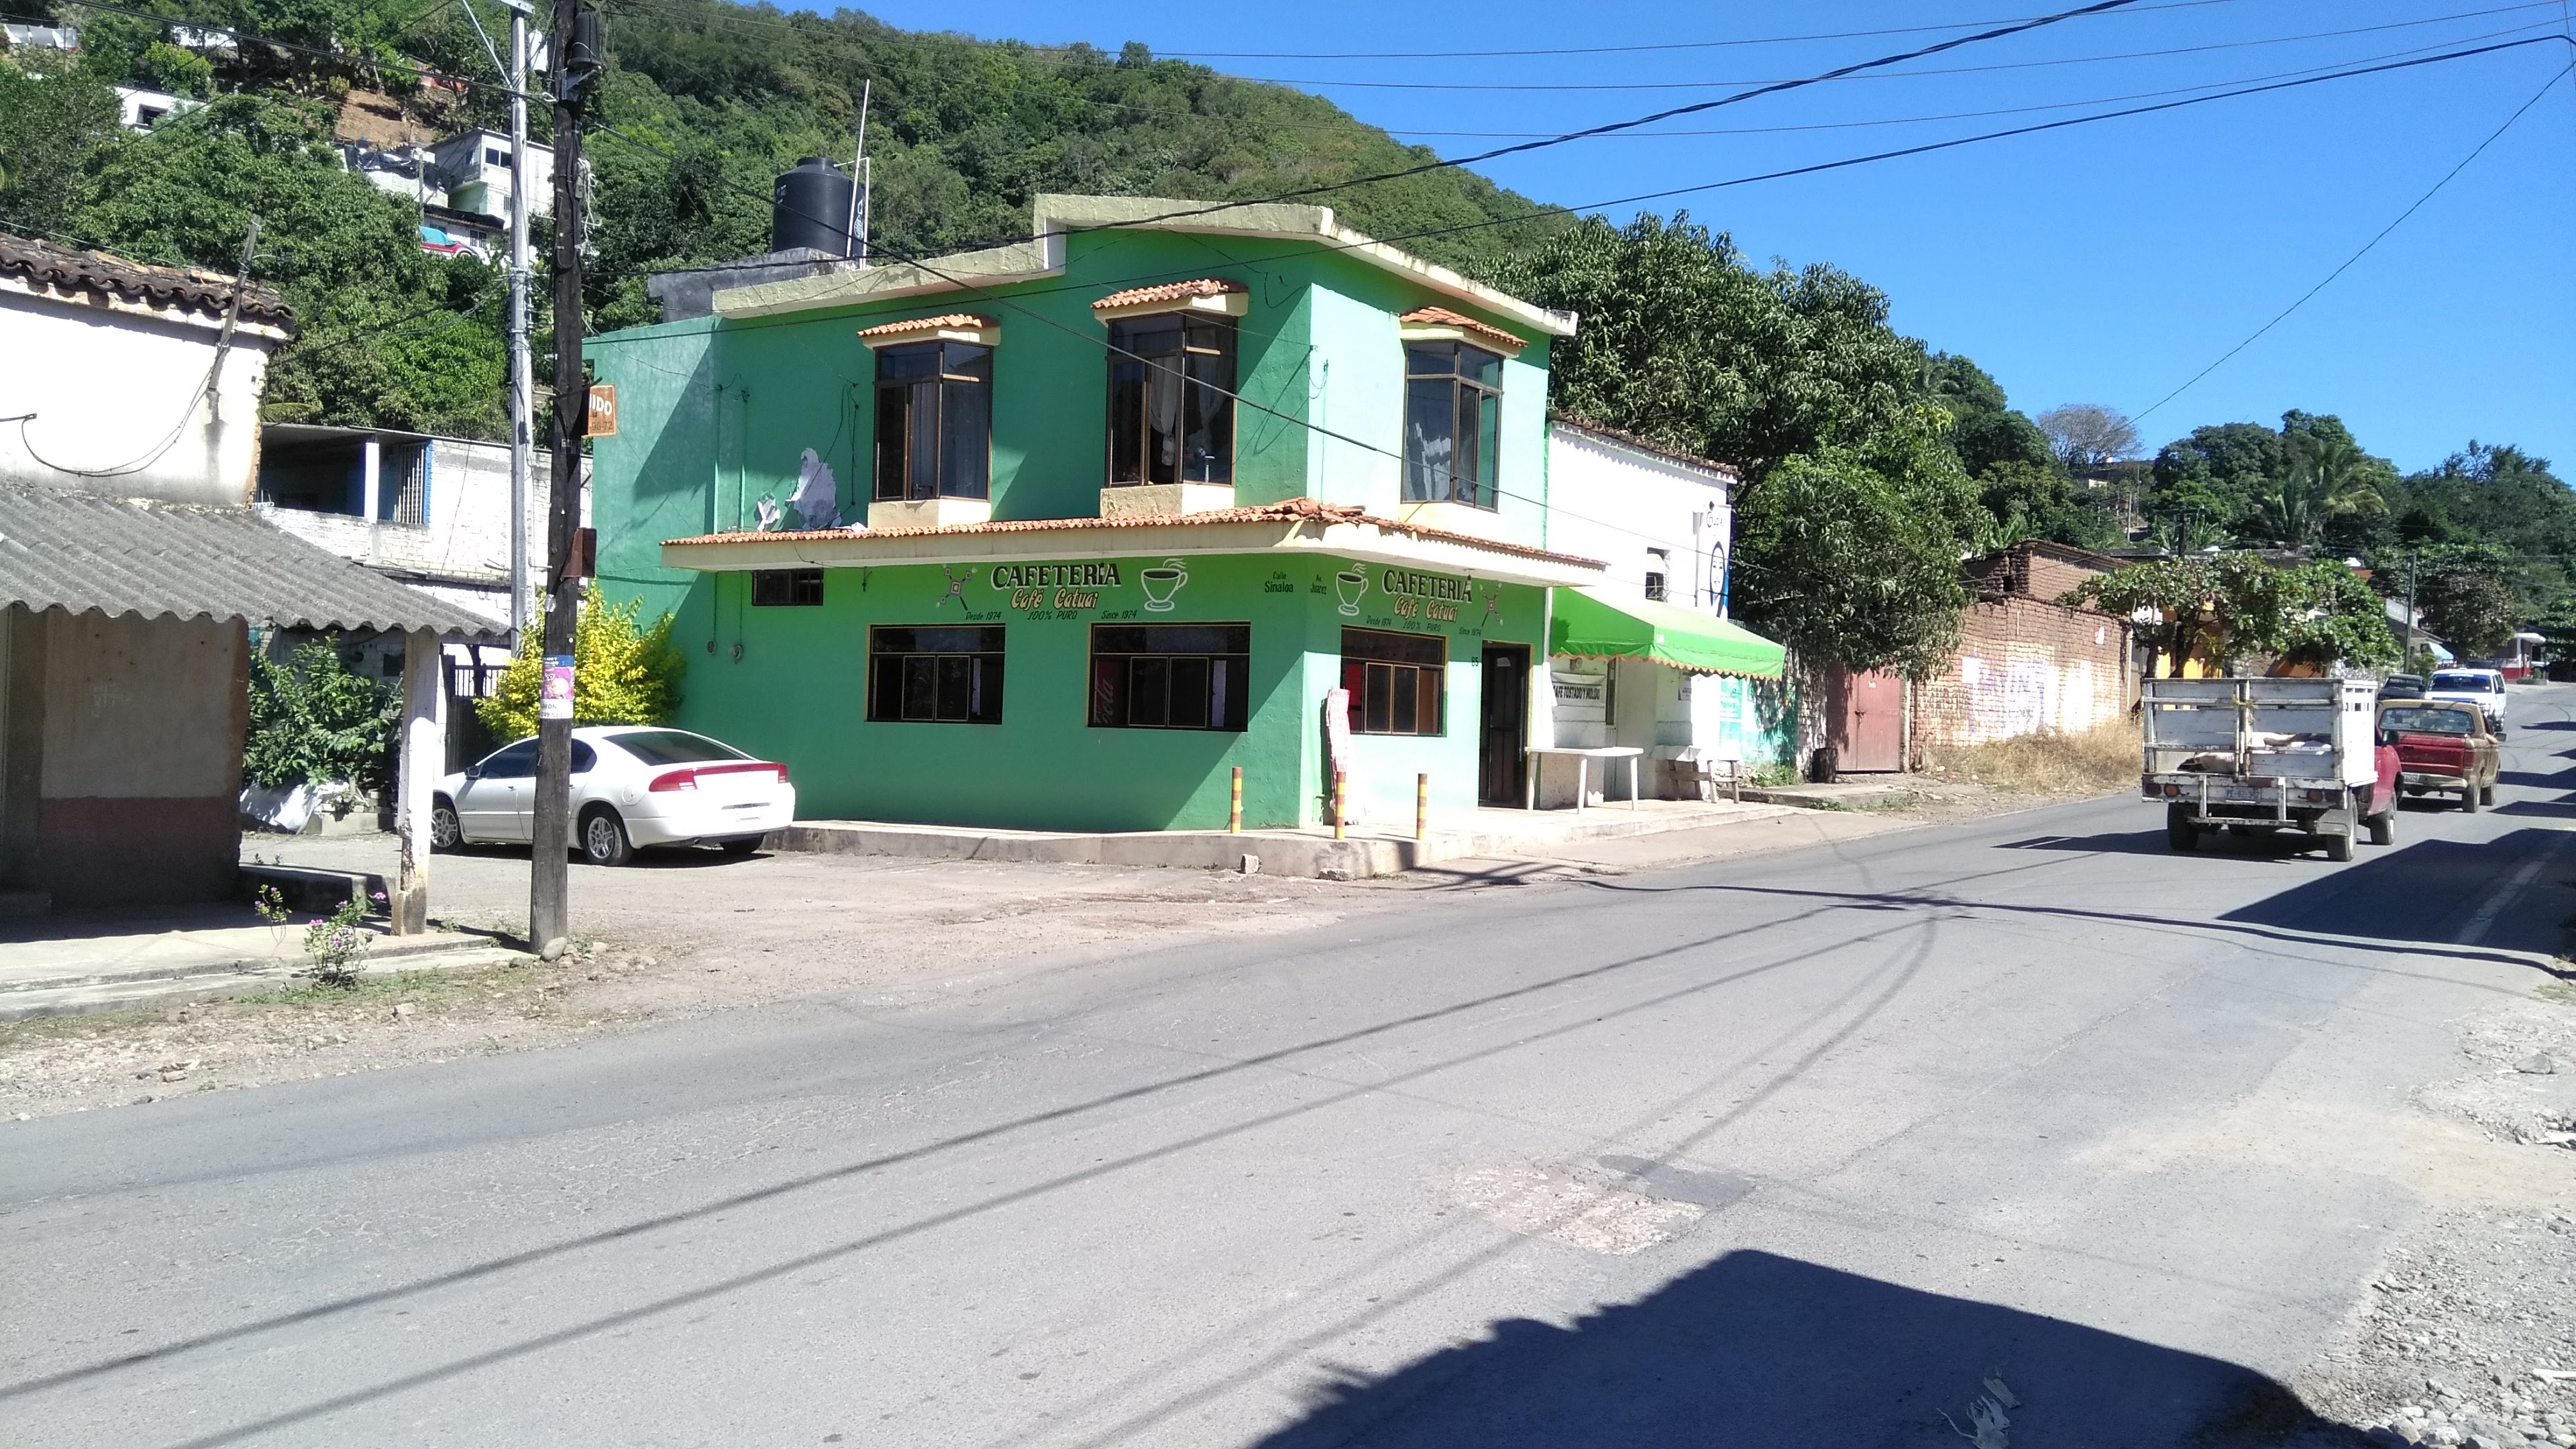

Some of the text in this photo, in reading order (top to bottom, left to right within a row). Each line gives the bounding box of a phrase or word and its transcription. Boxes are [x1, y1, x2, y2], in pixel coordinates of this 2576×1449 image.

[991, 563, 1121, 590] CAFETERIA
[1273, 571, 1287, 580] Calle
[1265, 580, 1293, 593] Sinaloa
[1382, 569, 1472, 604] CAFETERIA
[1011, 588, 1044, 610] Café
[1393, 595, 1419, 620] Café
[965, 611, 1001, 620] Desde 1974
[1027, 610, 1078, 621] 100% PURO
[1101, 609, 1137, 619] Since 1974
[1366, 615, 1392, 627] Desde 1974
[1403, 621, 1441, 633] 100% PURO
[1564, 686, 1582, 700] TOSTADO
